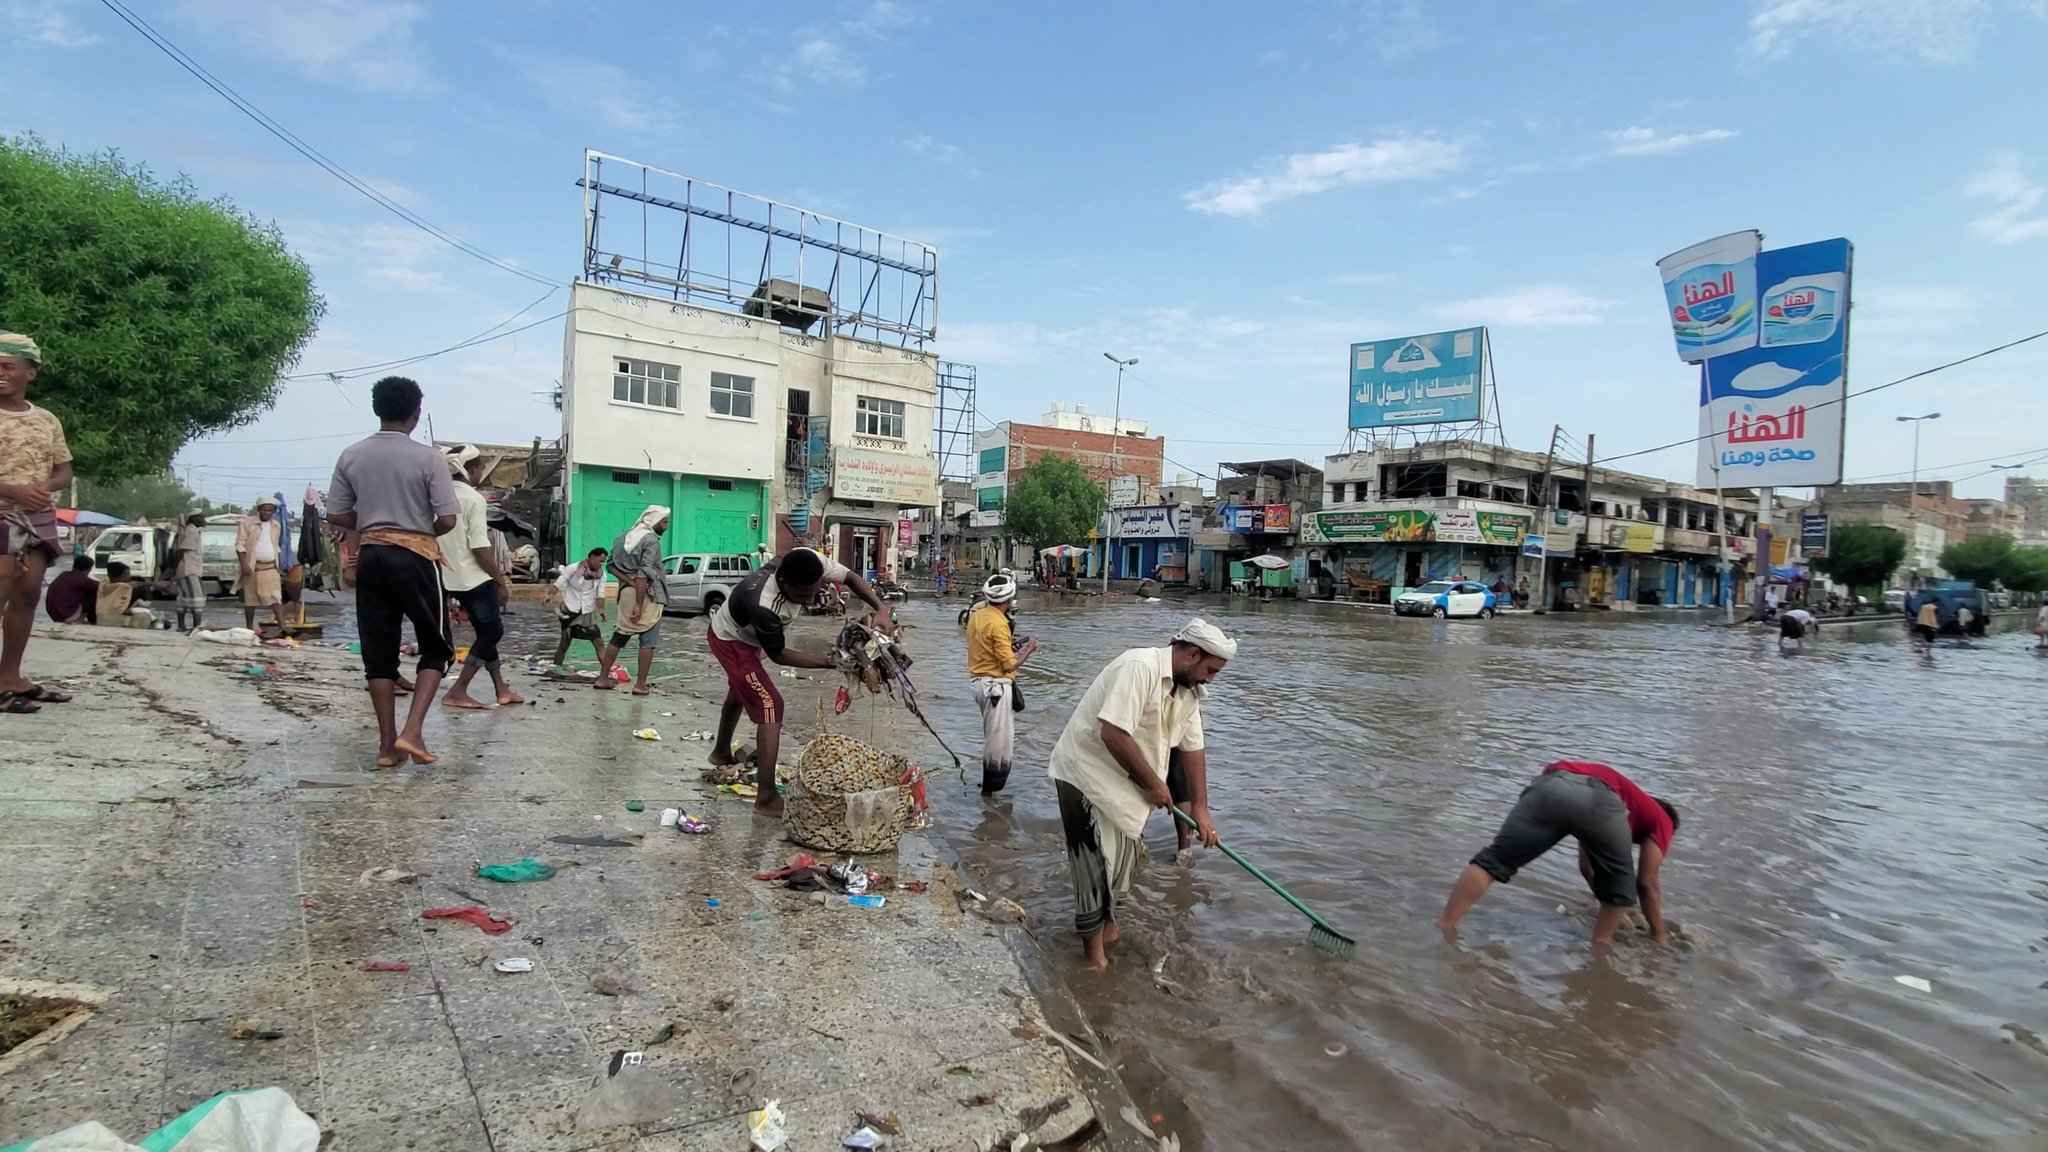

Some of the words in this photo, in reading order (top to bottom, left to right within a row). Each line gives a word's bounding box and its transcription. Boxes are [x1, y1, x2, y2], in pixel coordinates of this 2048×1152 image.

[1684, 271, 1734, 306] الهنا
[1355, 380, 1374, 405] الله
[1376, 380, 1412, 407] رسول
[1728, 403, 1805, 444] الهنا
[1768, 447, 1816, 462] صحة
